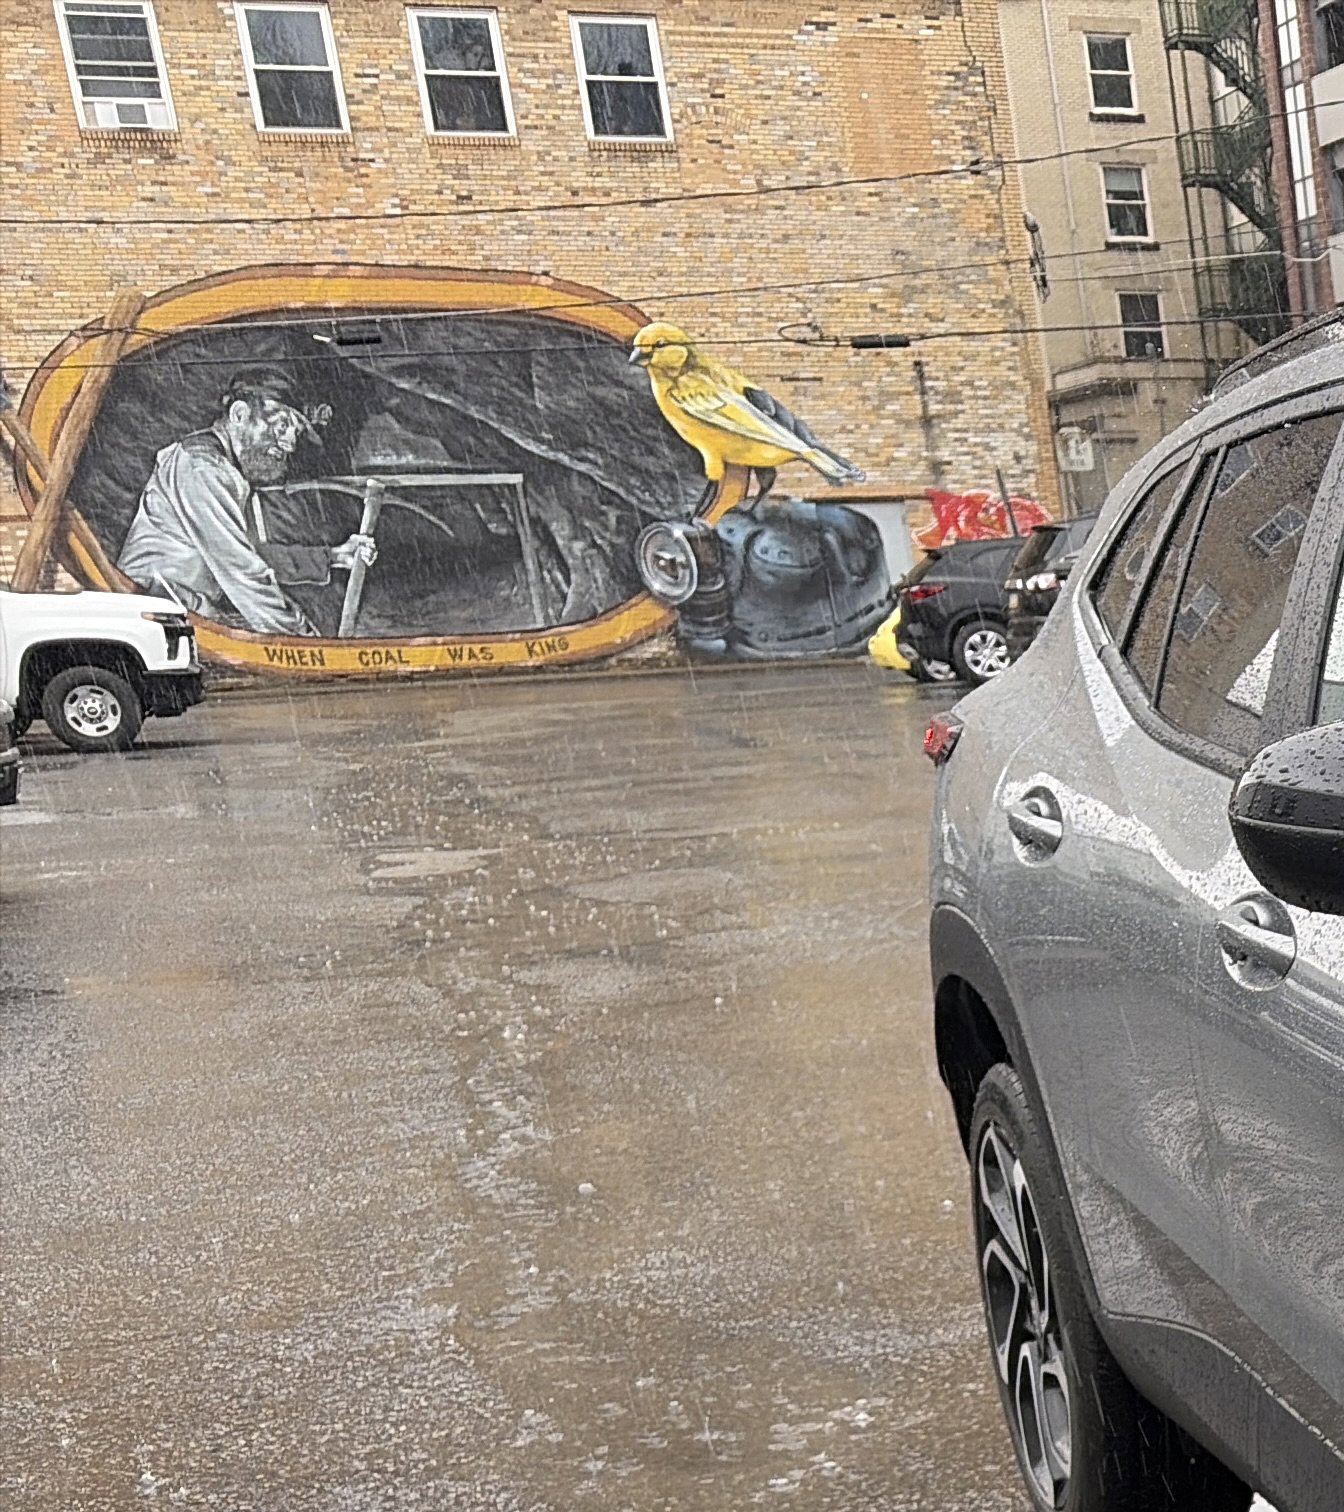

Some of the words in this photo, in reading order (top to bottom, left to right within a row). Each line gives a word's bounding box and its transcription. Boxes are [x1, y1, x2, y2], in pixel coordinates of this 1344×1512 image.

[264, 646, 325, 667] WHEN
[358, 649, 410, 667] COAL
[447, 646, 495, 664] WAS
[525, 636, 570, 659] KING
